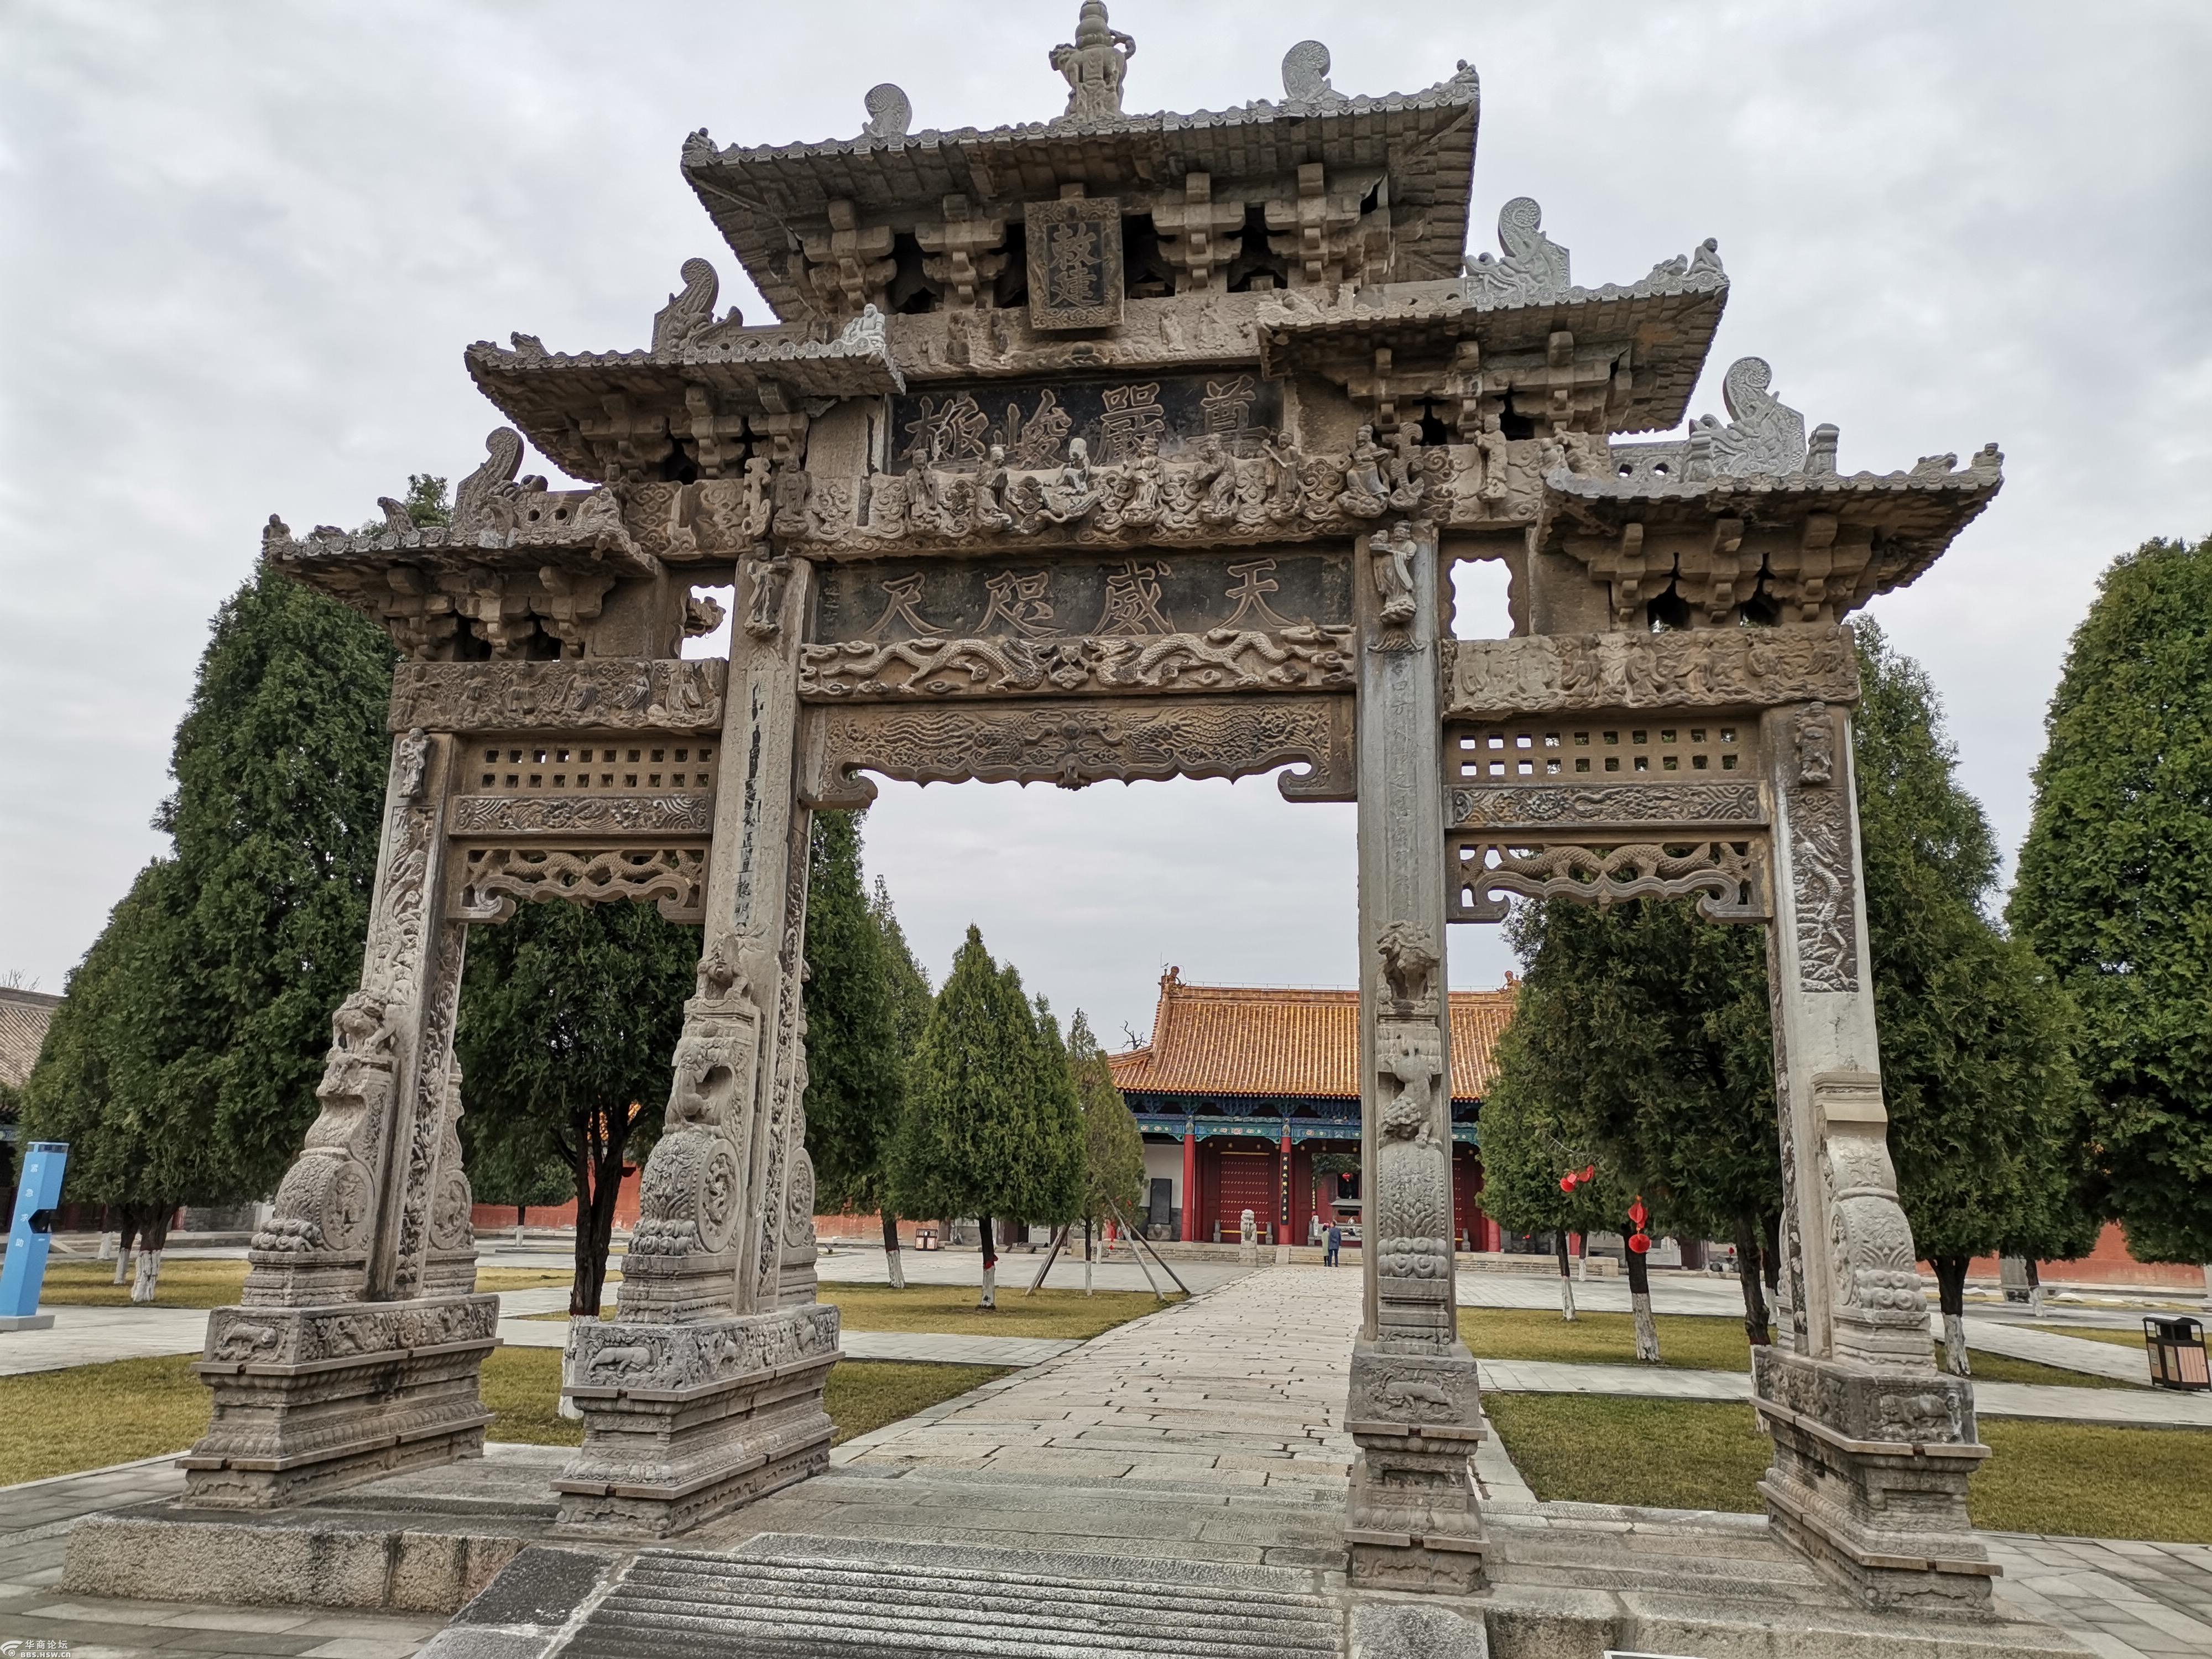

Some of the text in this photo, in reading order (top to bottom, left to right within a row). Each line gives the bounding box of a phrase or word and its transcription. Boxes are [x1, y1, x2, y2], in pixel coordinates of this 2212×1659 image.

[865, 558, 1303, 639] 天威咫尺
[15, 1164, 39, 1248] 紧急求助
